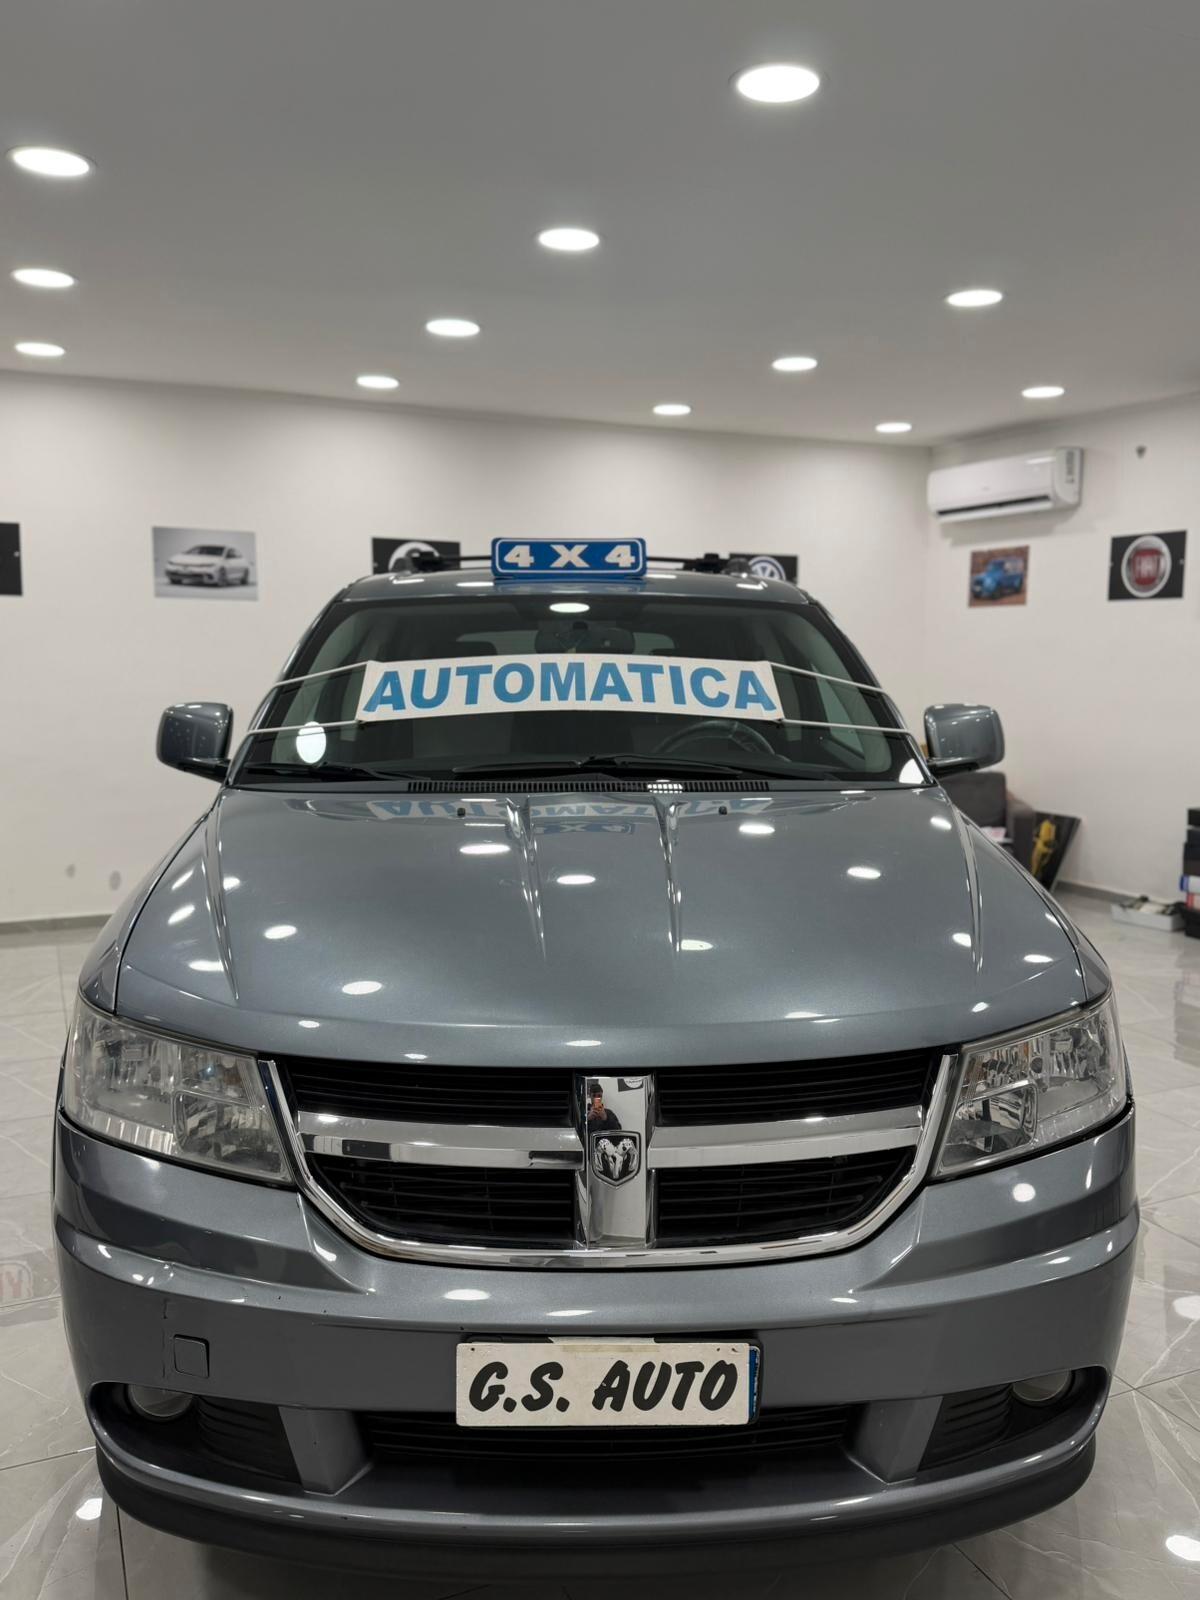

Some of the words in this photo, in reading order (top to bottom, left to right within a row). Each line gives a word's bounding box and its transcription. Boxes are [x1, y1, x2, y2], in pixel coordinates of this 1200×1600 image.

[503, 545, 534, 567] 4
[550, 544, 590, 567] X
[604, 545, 636, 567] 4
[362, 662, 777, 713] AUTOMATICA
[469, 1361, 570, 1413] G.S.
[591, 1359, 738, 1413] AUTO
